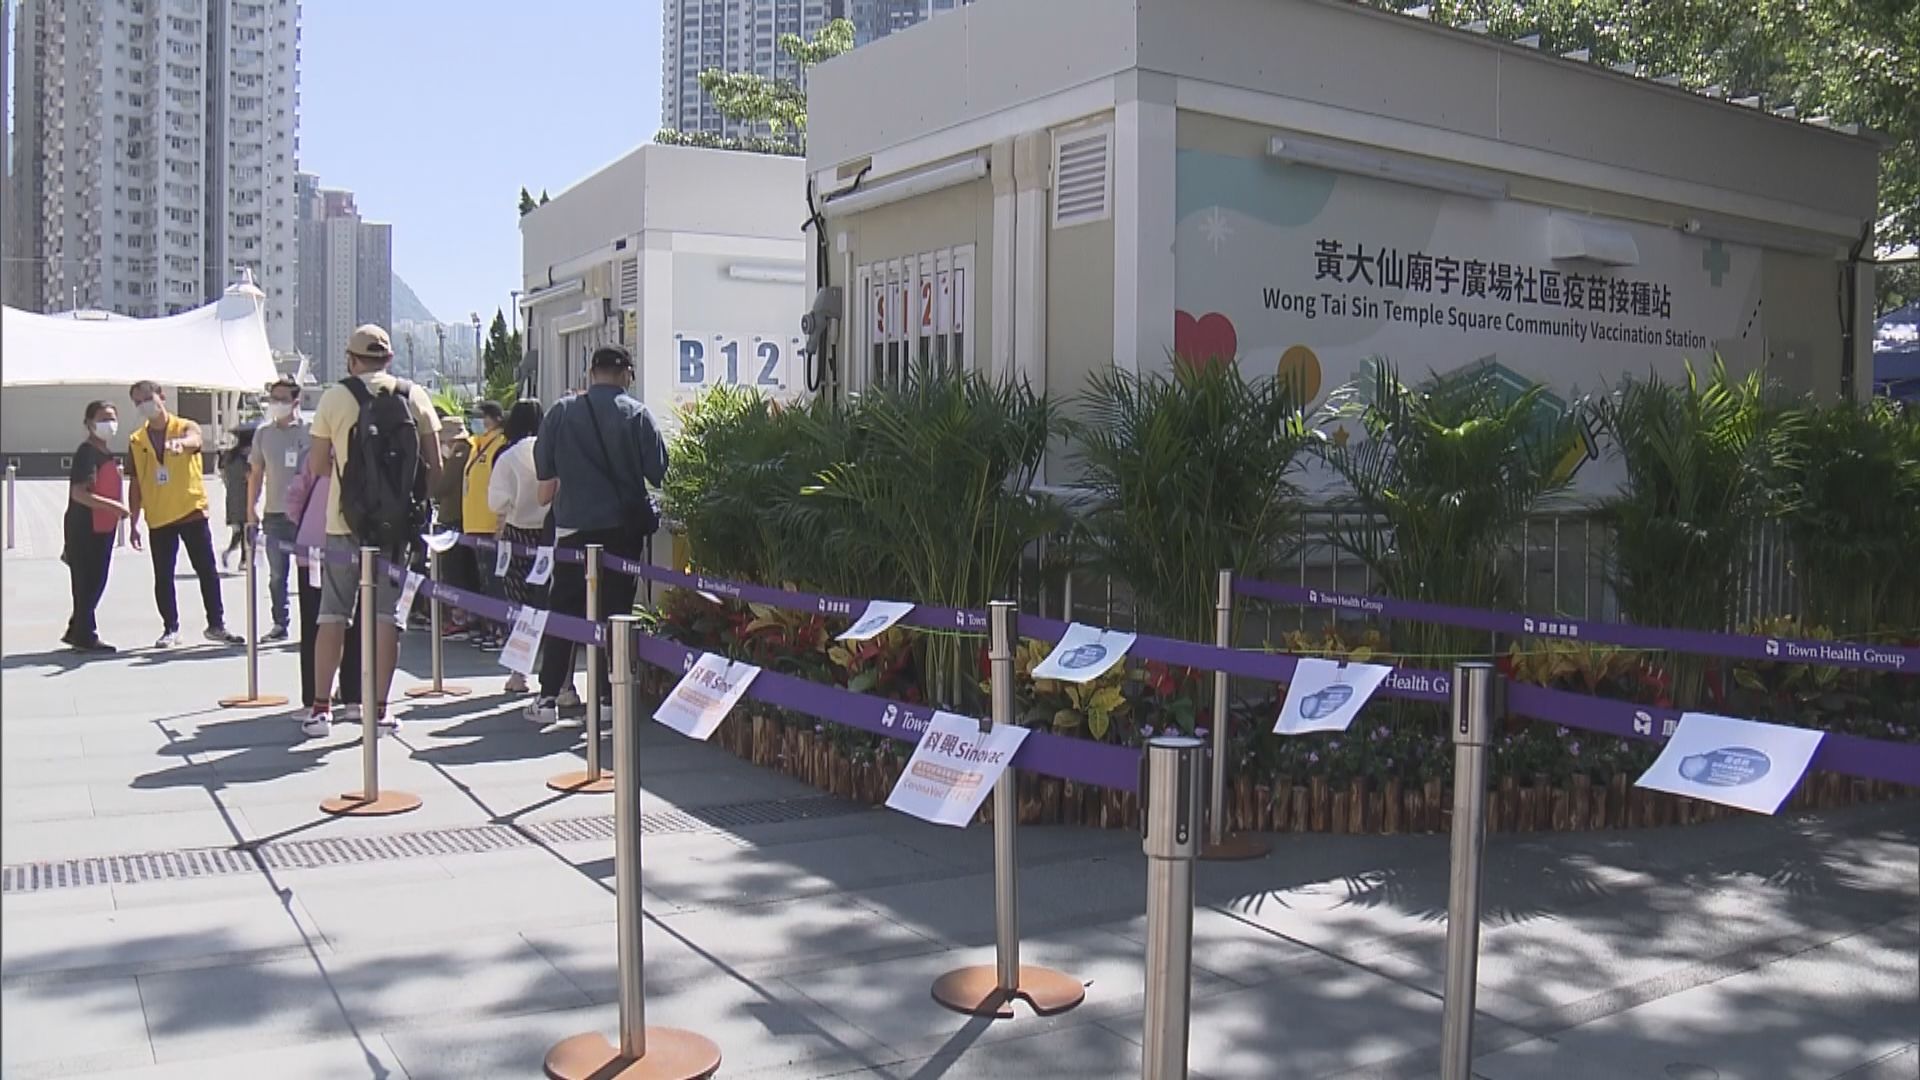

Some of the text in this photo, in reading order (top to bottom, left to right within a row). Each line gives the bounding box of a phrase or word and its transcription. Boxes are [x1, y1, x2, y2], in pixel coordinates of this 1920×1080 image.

[1314, 238, 1671, 319] 黃大仙廟宇廣場社區疫苗接種站
[1263, 288, 1706, 350] Wong Tai Sin Temple Square Community Vaccination Station
[1786, 642, 1905, 669] Town Health Group
[1385, 674, 1429, 691] Health
[955, 741, 1006, 765] Sinovac
